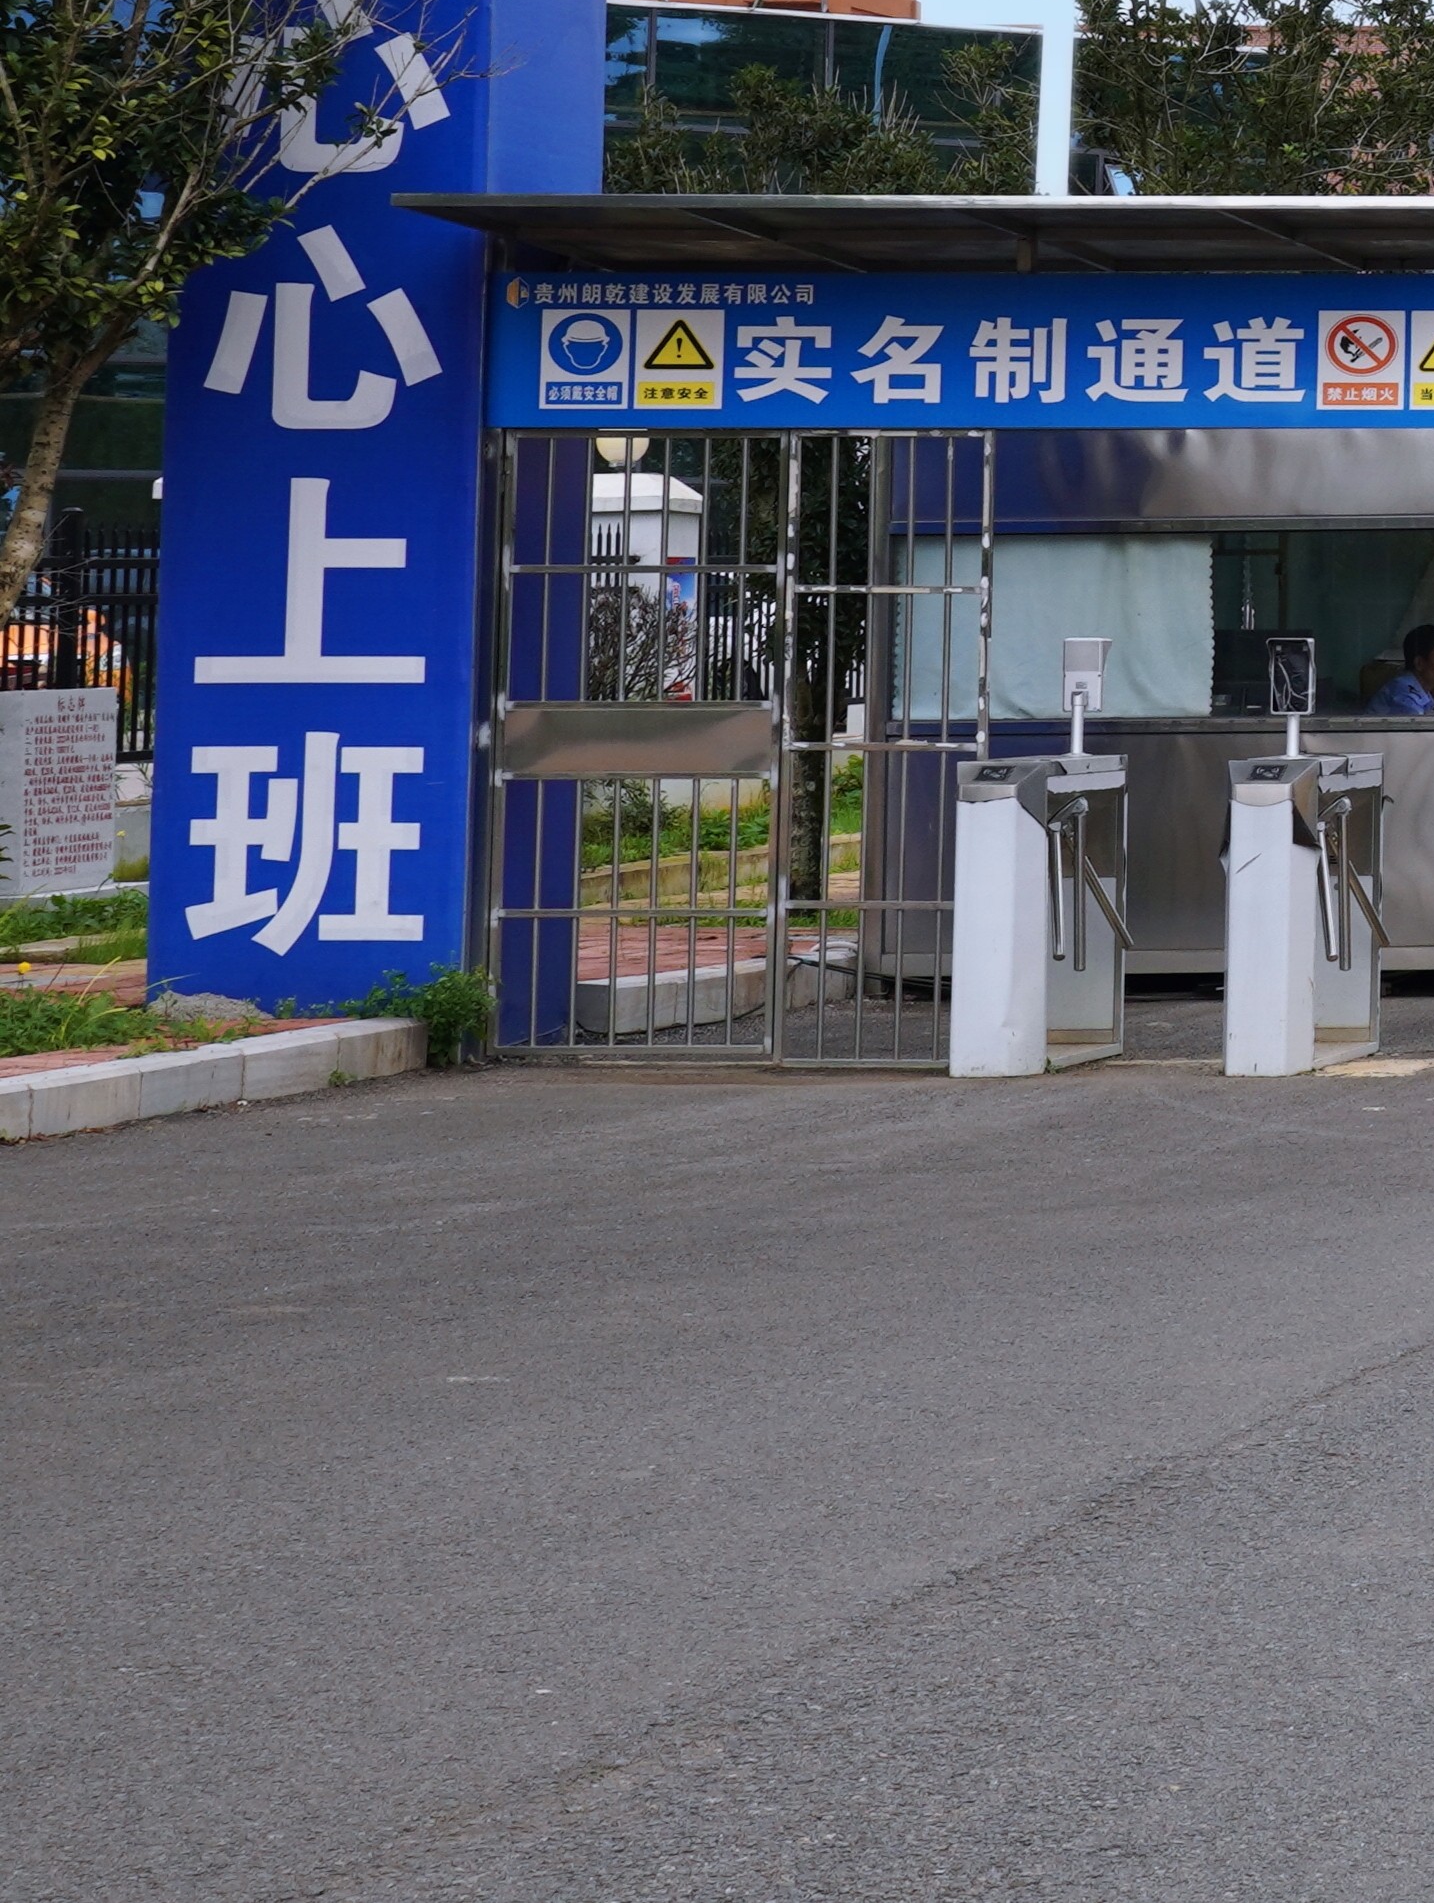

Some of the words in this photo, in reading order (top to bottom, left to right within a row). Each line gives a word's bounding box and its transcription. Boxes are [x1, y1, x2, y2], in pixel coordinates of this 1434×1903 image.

[534, 283, 815, 306] 贵州朗乾建设发展有限公司
[734, 315, 1307, 405] 实名制通道
[548, 386, 618, 403] 必须戴安全帽
[643, 387, 709, 401] 注意安全
[1326, 385, 1397, 403] 禁止烟火
